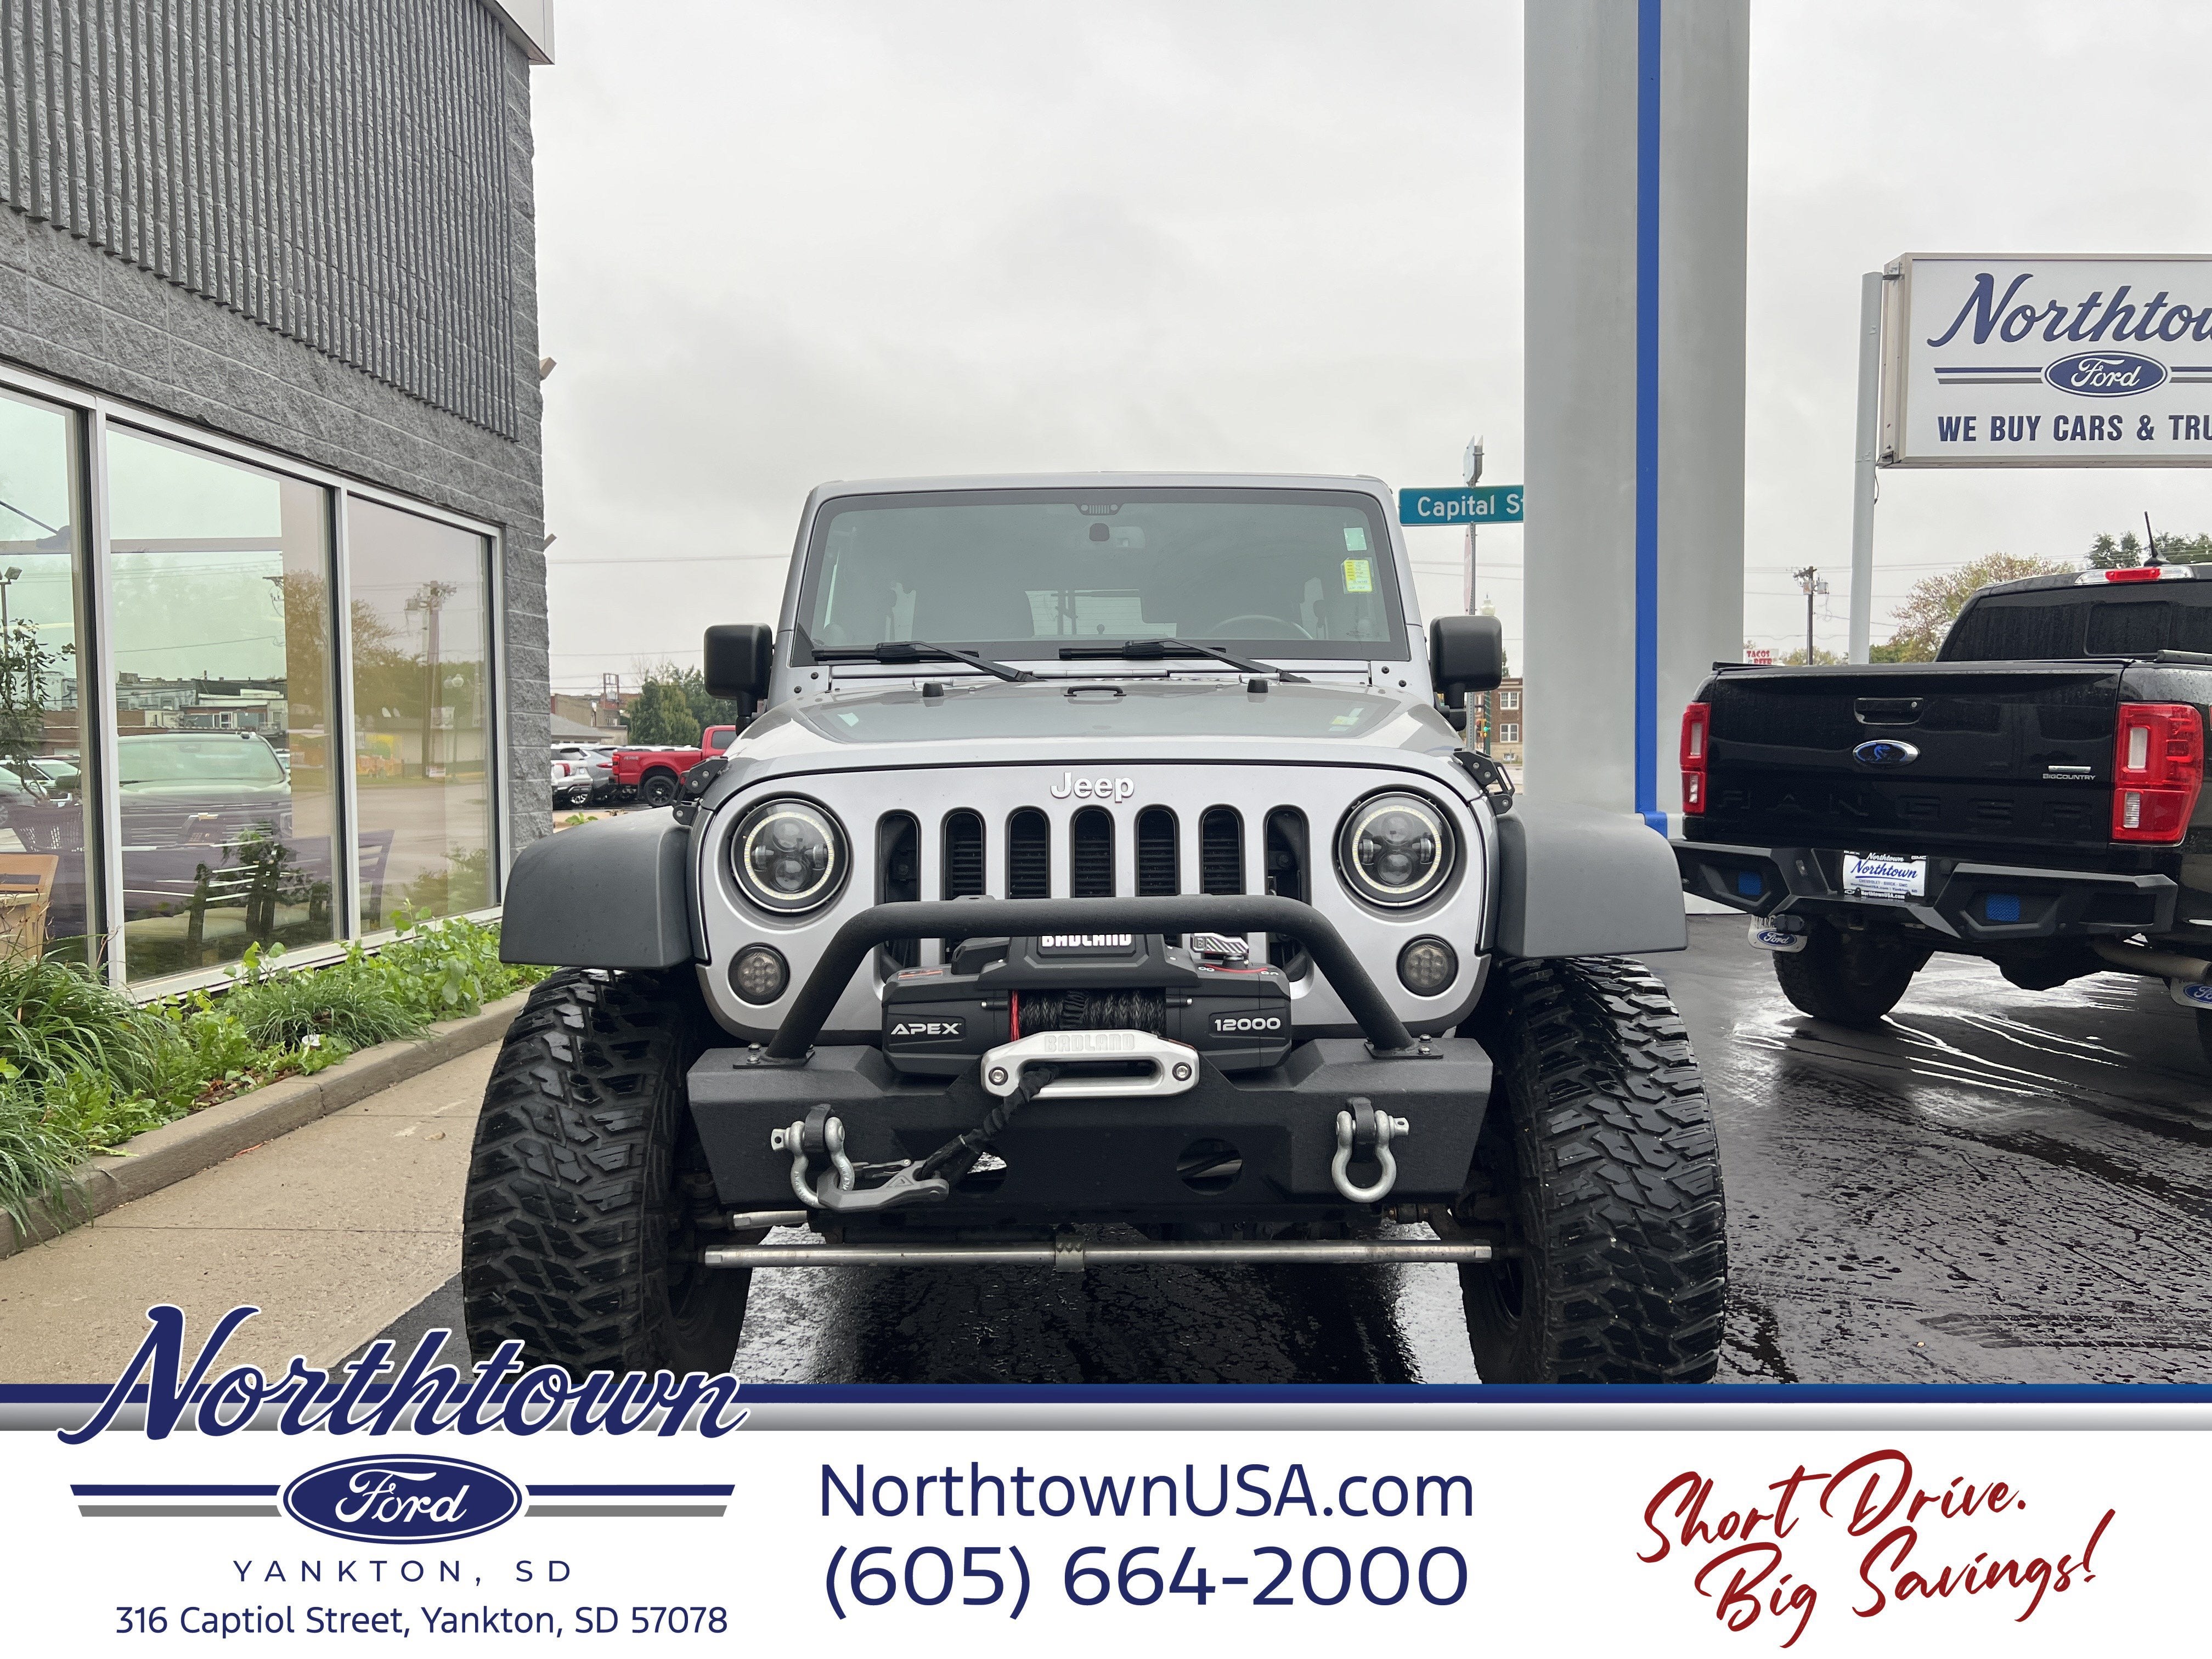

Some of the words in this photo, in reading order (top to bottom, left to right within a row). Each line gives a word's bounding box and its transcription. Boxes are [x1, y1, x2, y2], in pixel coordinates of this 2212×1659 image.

[2071, 357, 2142, 387] Ford
[1937, 415, 1977, 442] WE
[1990, 415, 2041, 442] BUY
[2053, 414, 2124, 441] CARS
[2136, 414, 2155, 441] &
[1417, 494, 1495, 522] Capital
[1505, 493, 1523, 515] S
[1050, 771, 1135, 804] Jeep
[1866, 852, 1905, 862] Northtown
[1850, 859, 1918, 878] Northtown
[1763, 932, 1790, 944] Ford
[890, 1023, 960, 1036] APEX
[1214, 1017, 1282, 1031] 12000
[1044, 1034, 1135, 1053] BADLAND
